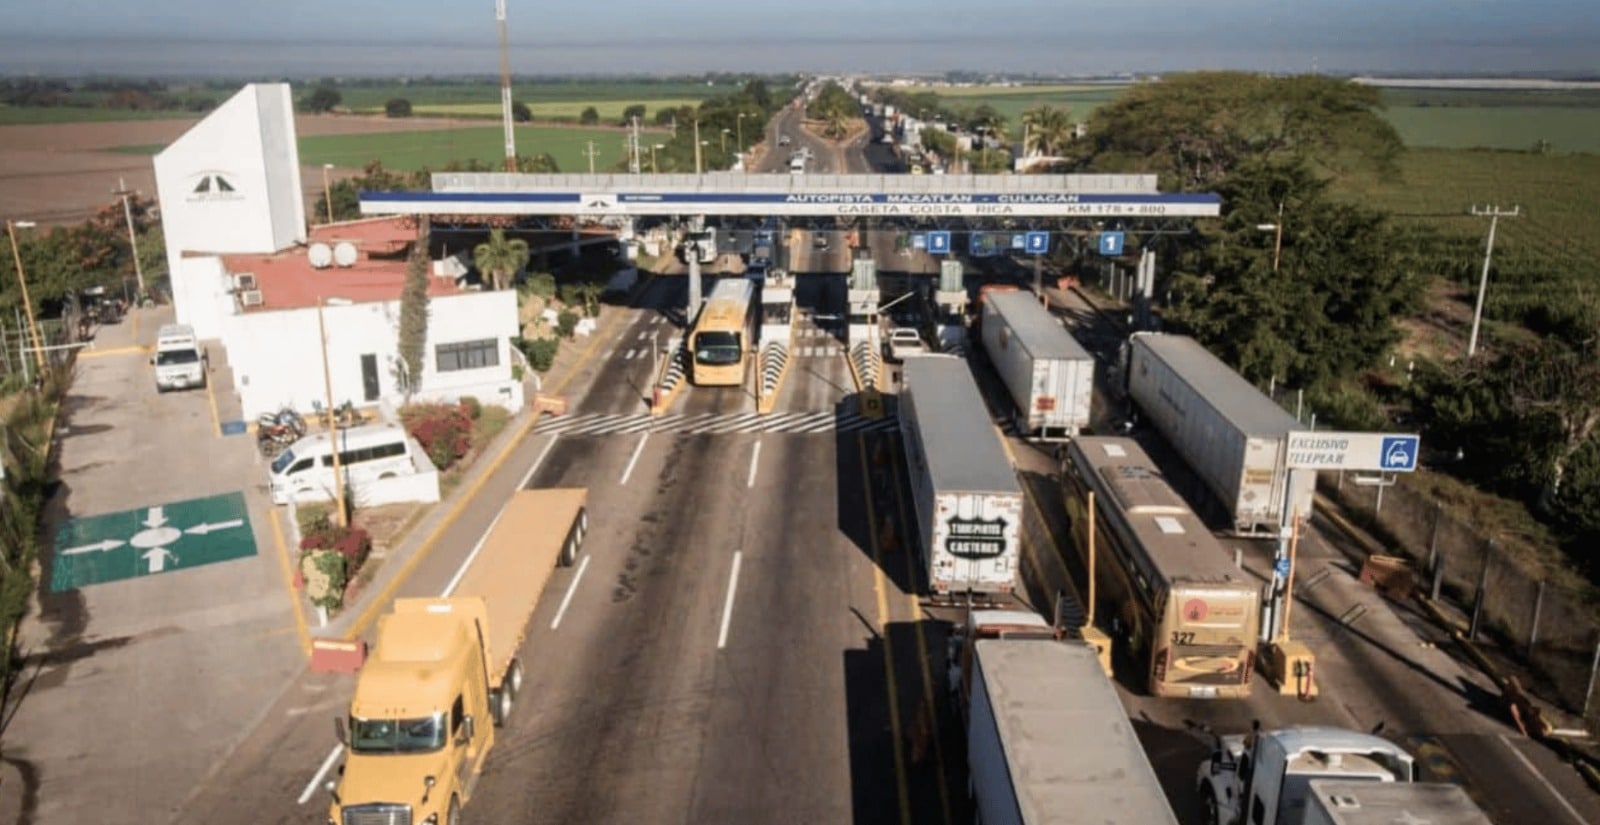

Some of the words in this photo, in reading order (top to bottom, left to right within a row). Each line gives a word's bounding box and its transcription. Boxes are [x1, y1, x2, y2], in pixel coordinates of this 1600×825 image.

[786, 193, 874, 203] AUTOPISTA
[837, 204, 900, 214] CASETA
[909, 204, 961, 214] COSTA
[975, 204, 1013, 214] RICA
[1067, 204, 1091, 214] KM
[1105, 235, 1117, 251] 1
[1290, 438, 1349, 451] EXCLUSIVO
[1289, 452, 1345, 465] TELEPEAJE
[1171, 631, 1196, 647] 327
